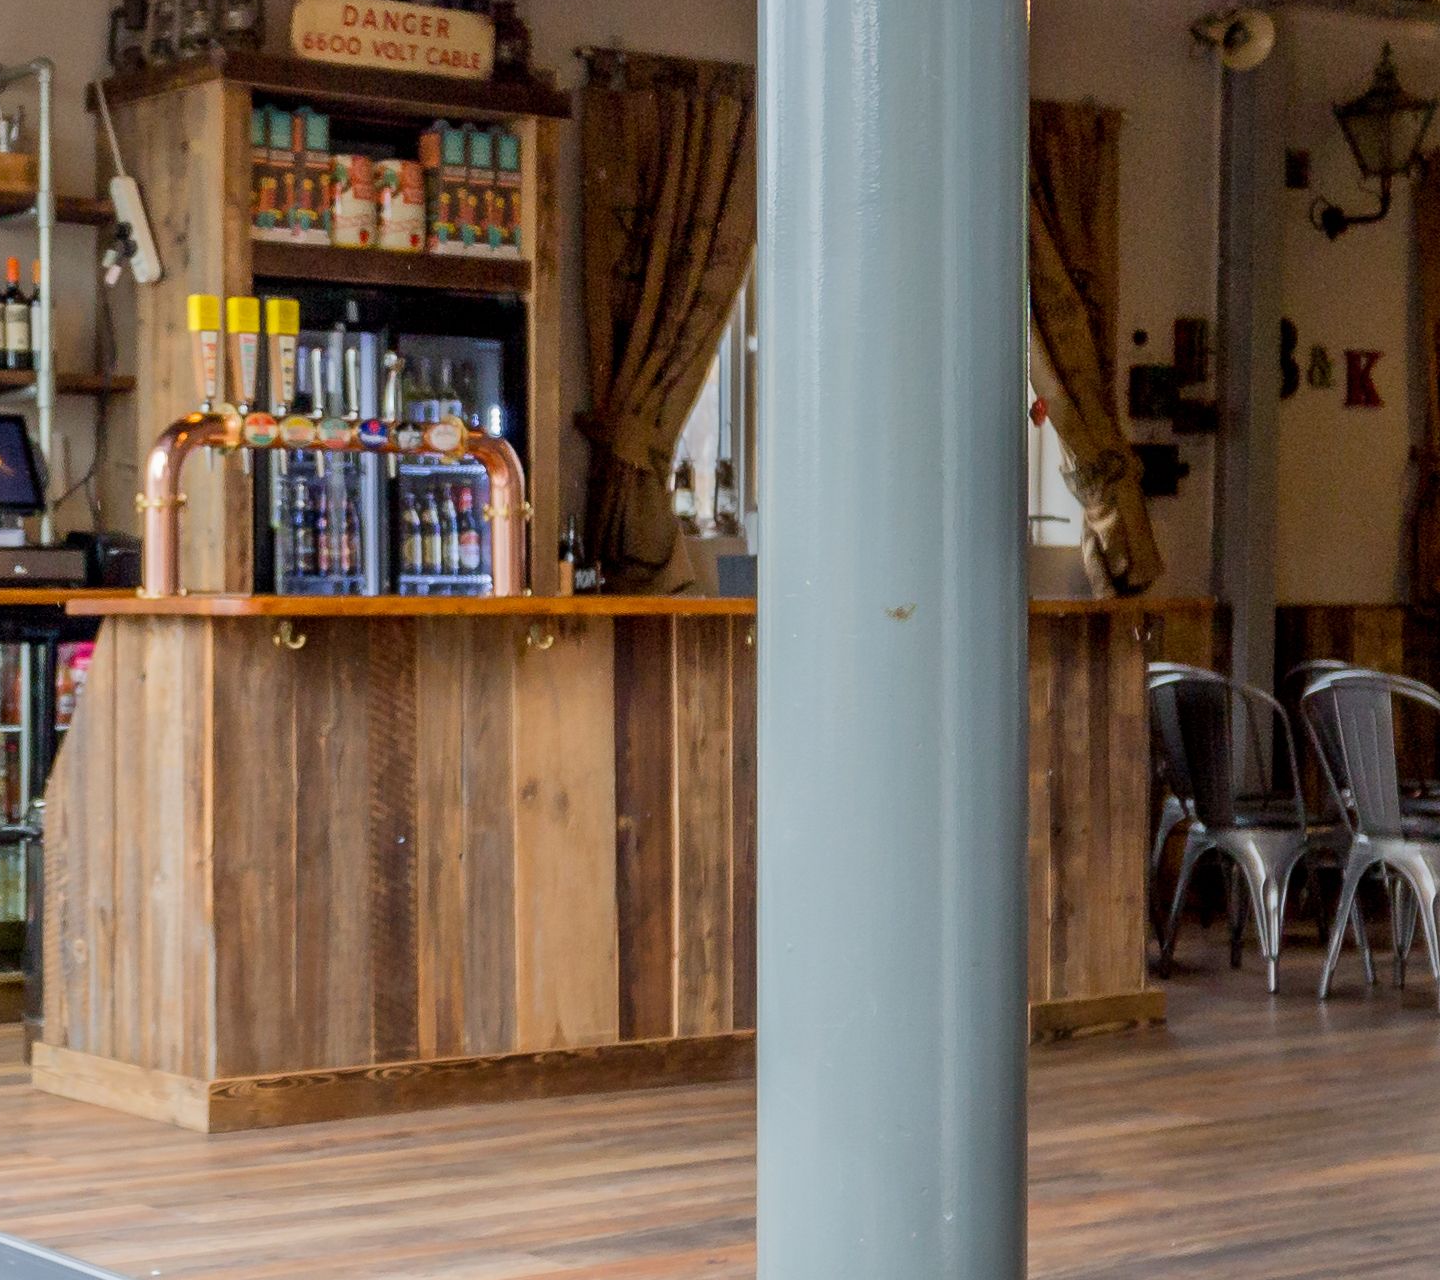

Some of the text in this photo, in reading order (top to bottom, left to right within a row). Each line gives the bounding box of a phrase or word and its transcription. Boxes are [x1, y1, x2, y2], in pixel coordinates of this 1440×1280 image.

[341, 3, 451, 40] DANGER
[372, 40, 419, 62] VOLT
[425, 45, 481, 70] CABLE
[1343, 347, 1385, 409] K
